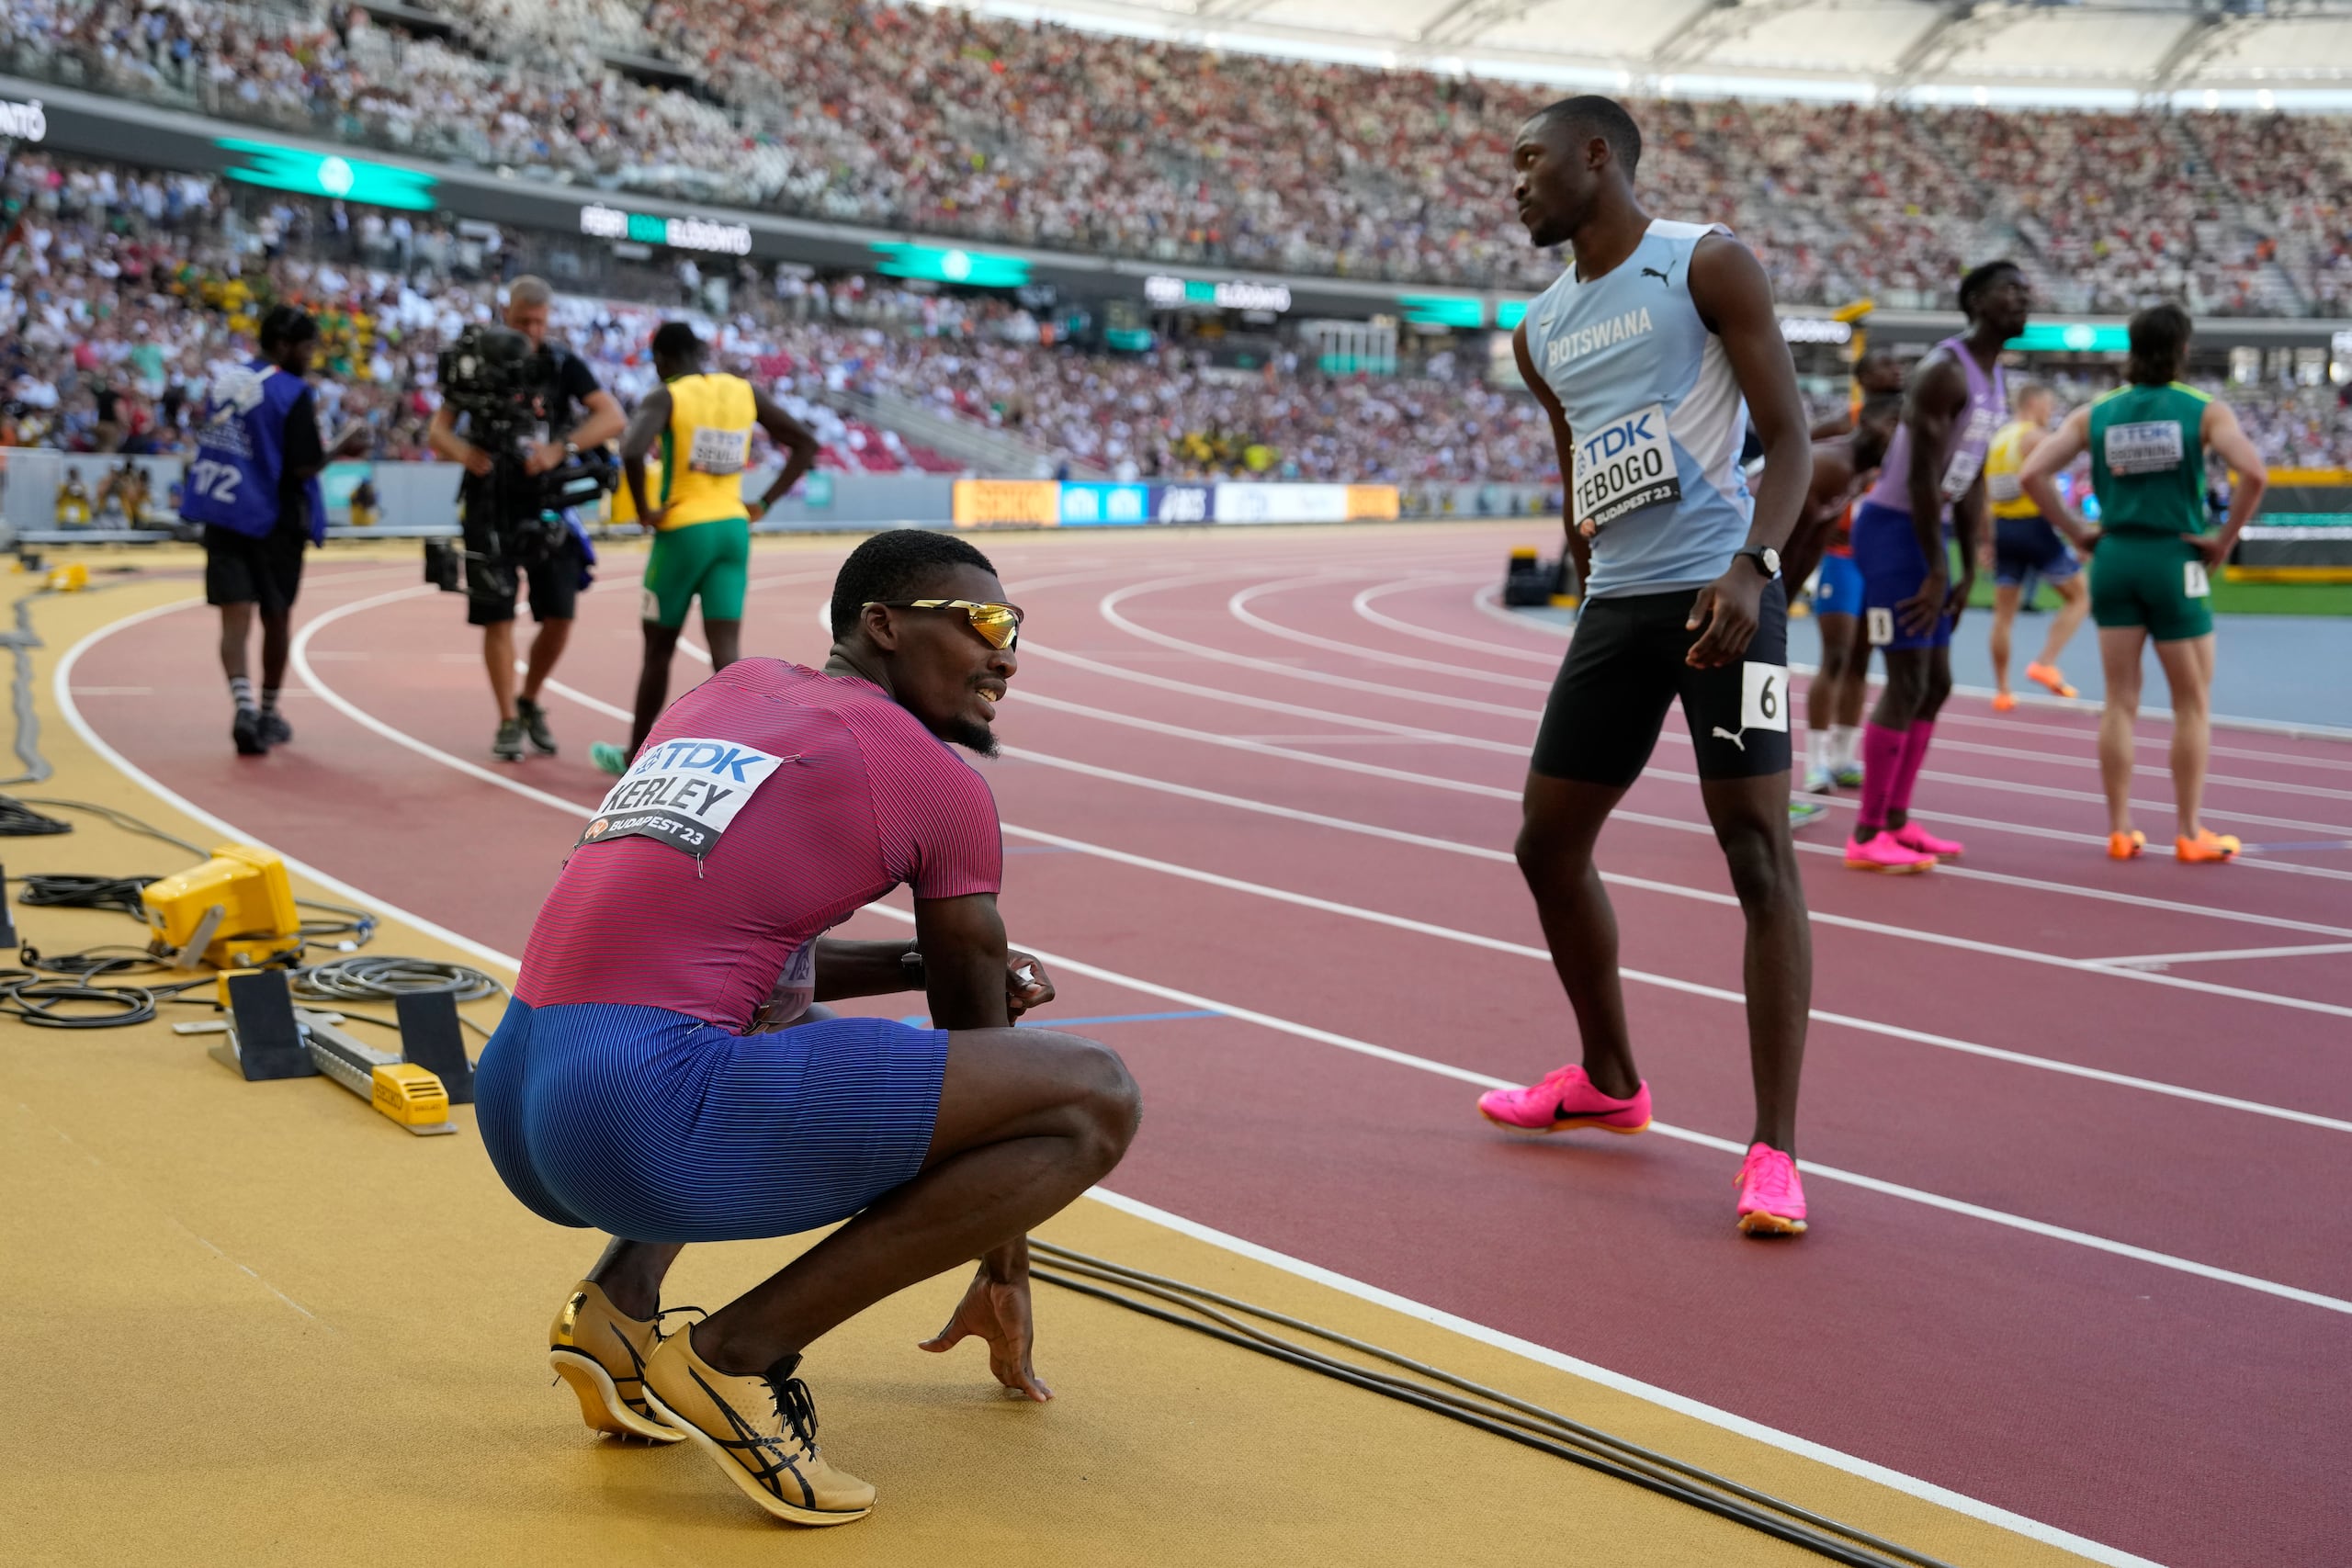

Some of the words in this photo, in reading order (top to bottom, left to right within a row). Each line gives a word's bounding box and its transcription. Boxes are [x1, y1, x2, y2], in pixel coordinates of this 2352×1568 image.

[1547, 306, 1653, 367] BOTSWANA
[1584, 413, 1657, 467] TDK
[1577, 447, 1663, 515] TEBOGO
[1594, 490, 1652, 525] BUDAPEST
[1654, 485, 1672, 501] 23
[1760, 675, 1777, 719] 6
[661, 742, 766, 784] TDK
[601, 776, 734, 817] KERLEY
[608, 815, 684, 834] BUDAPEST
[679, 827, 706, 846] 23
[376, 1082, 403, 1111] SEIKO
